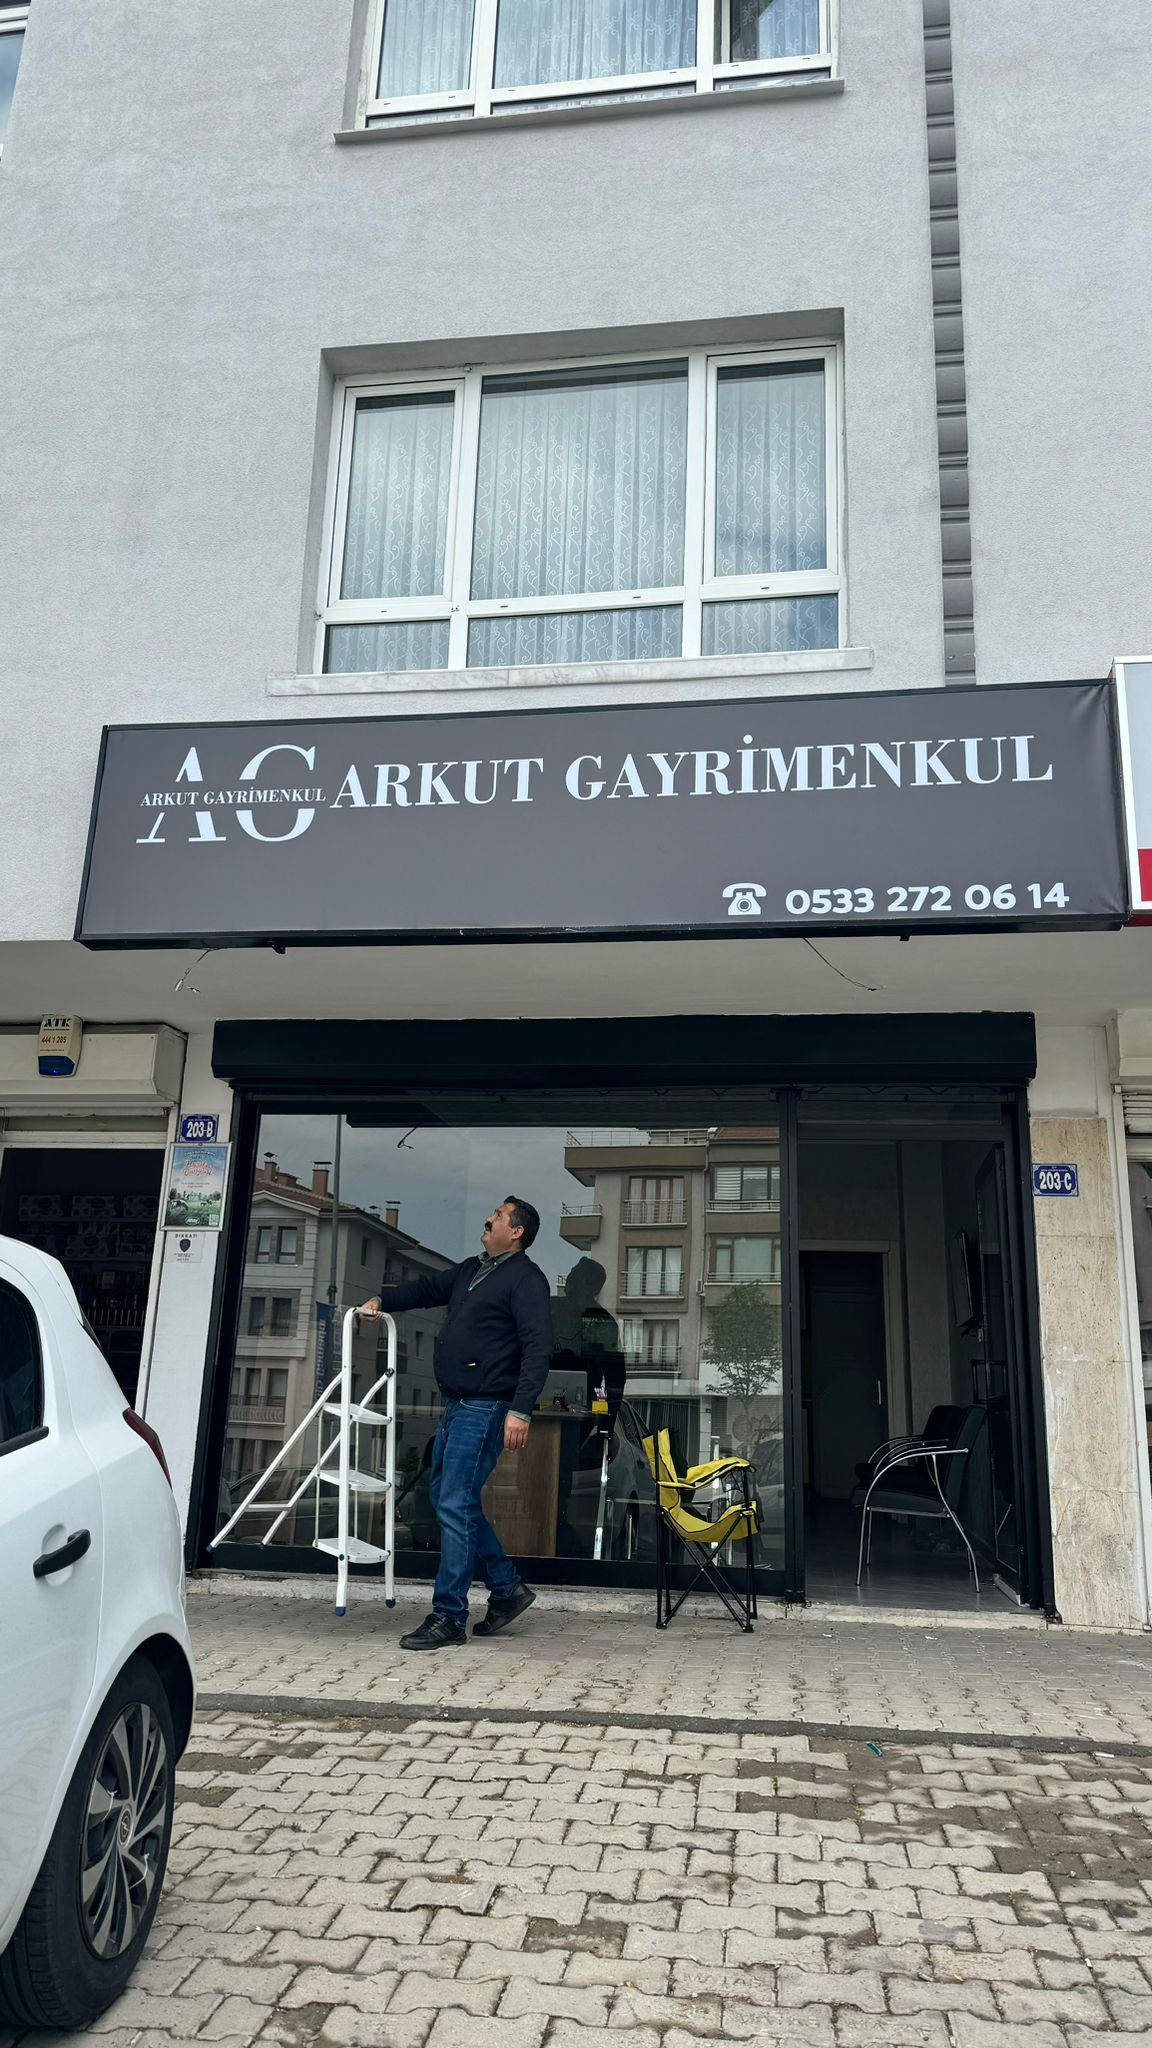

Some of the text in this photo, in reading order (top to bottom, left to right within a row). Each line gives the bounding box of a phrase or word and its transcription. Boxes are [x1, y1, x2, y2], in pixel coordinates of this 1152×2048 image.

[330, 734, 1055, 810] ARKUT GAYRİMENKUL
[140, 786, 327, 807] ARKUT GAYRİMENKUL
[785, 882, 1071, 916] 0533 272 06 14
[44, 1018, 71, 1027] ATK
[41, 1035, 52, 1044] 444
[186, 1121, 214, 1138] 203-B
[1039, 1171, 1073, 1191] 203-C
